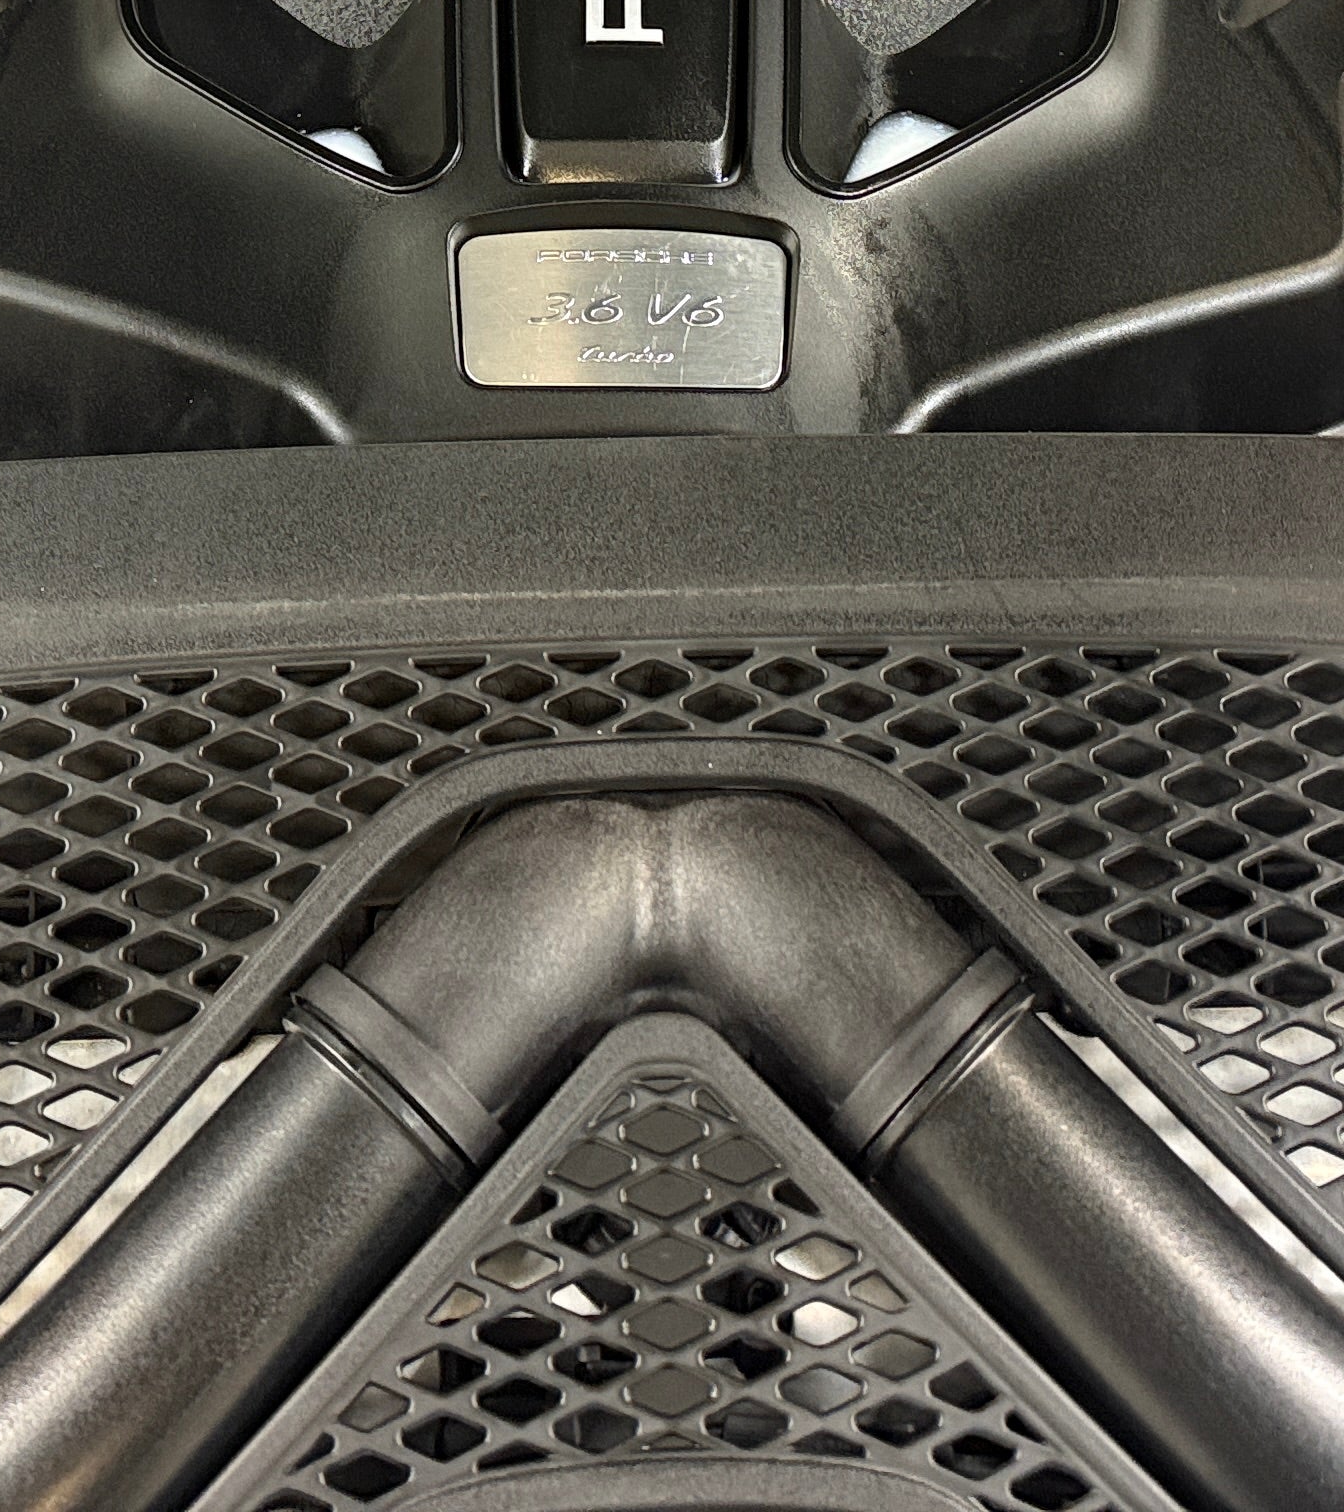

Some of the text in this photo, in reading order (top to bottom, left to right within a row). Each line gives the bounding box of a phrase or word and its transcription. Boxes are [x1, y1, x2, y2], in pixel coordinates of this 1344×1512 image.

[536, 249, 714, 265] PORSCHE
[527, 292, 724, 327] 3.6 V6
